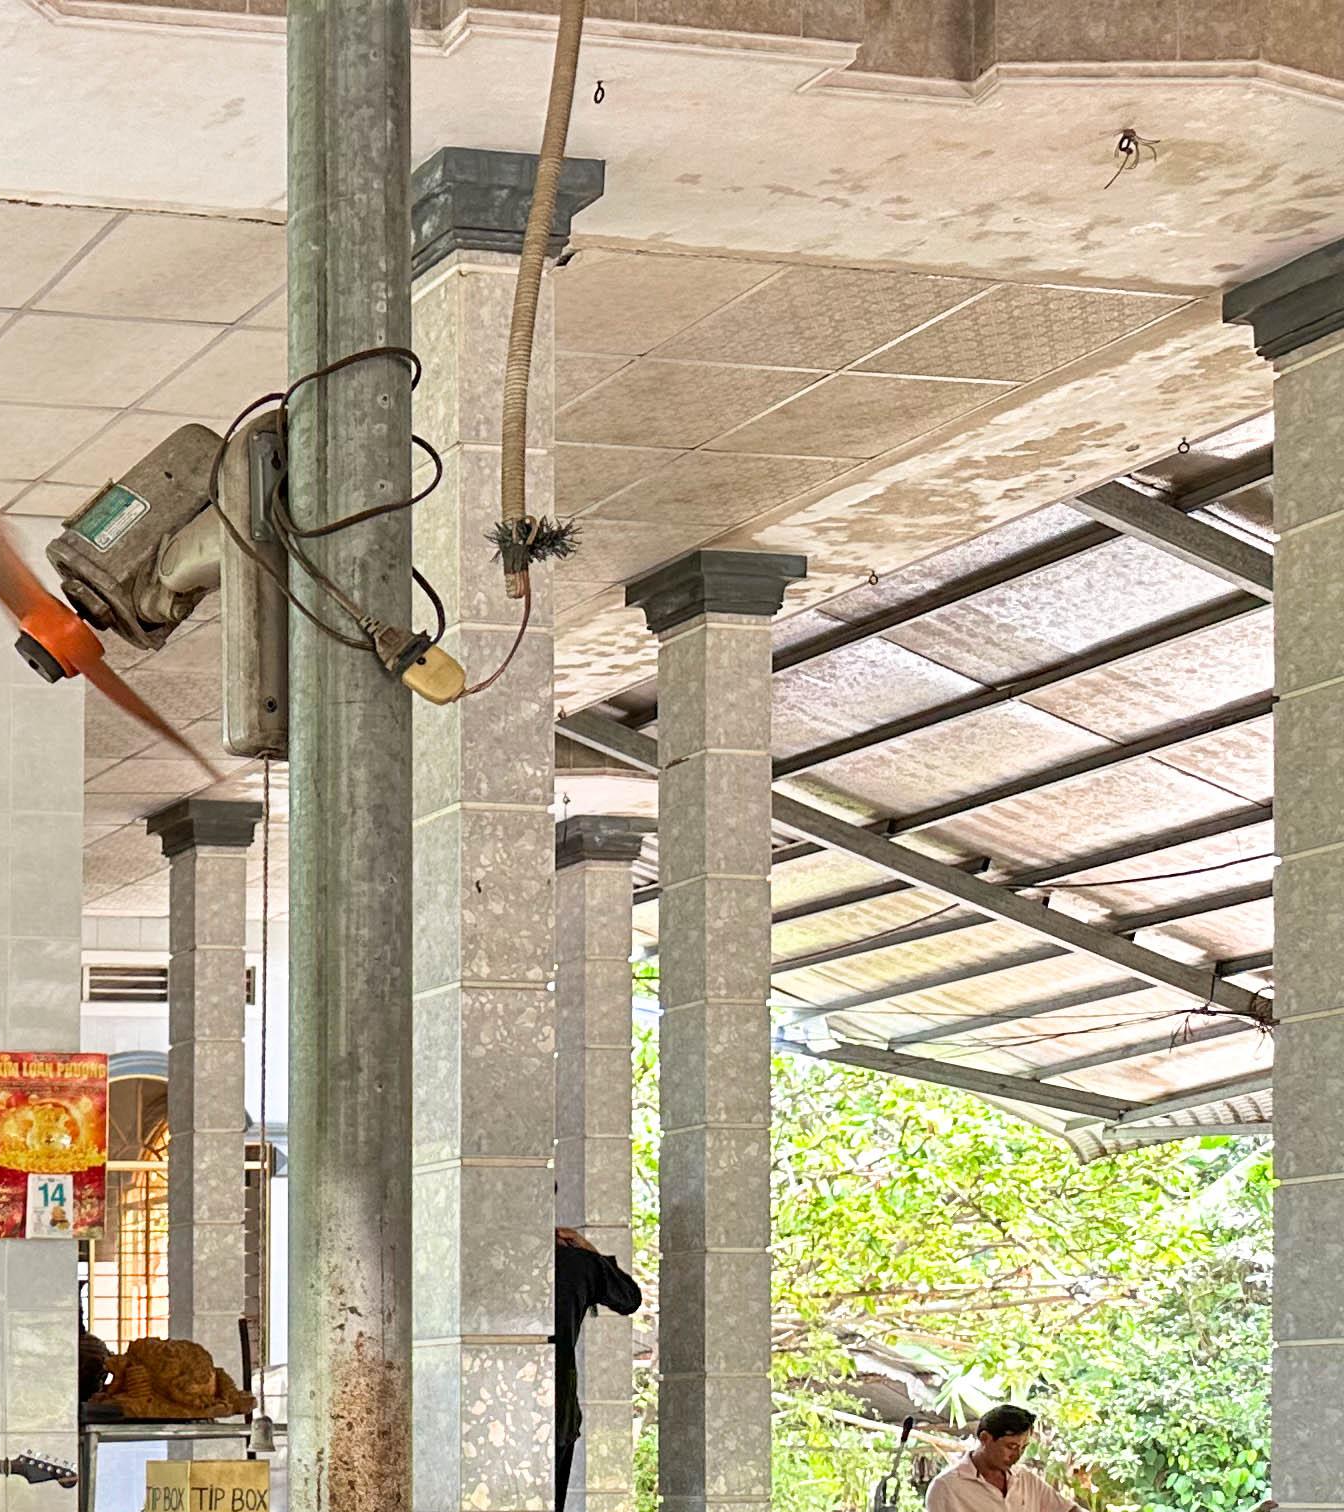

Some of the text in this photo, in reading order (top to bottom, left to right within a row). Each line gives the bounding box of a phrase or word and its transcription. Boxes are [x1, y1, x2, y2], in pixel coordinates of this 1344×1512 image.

[38, 1182, 66, 1207] 14
[163, 1486, 185, 1512] BOX
[231, 1487, 269, 1512] BOX
